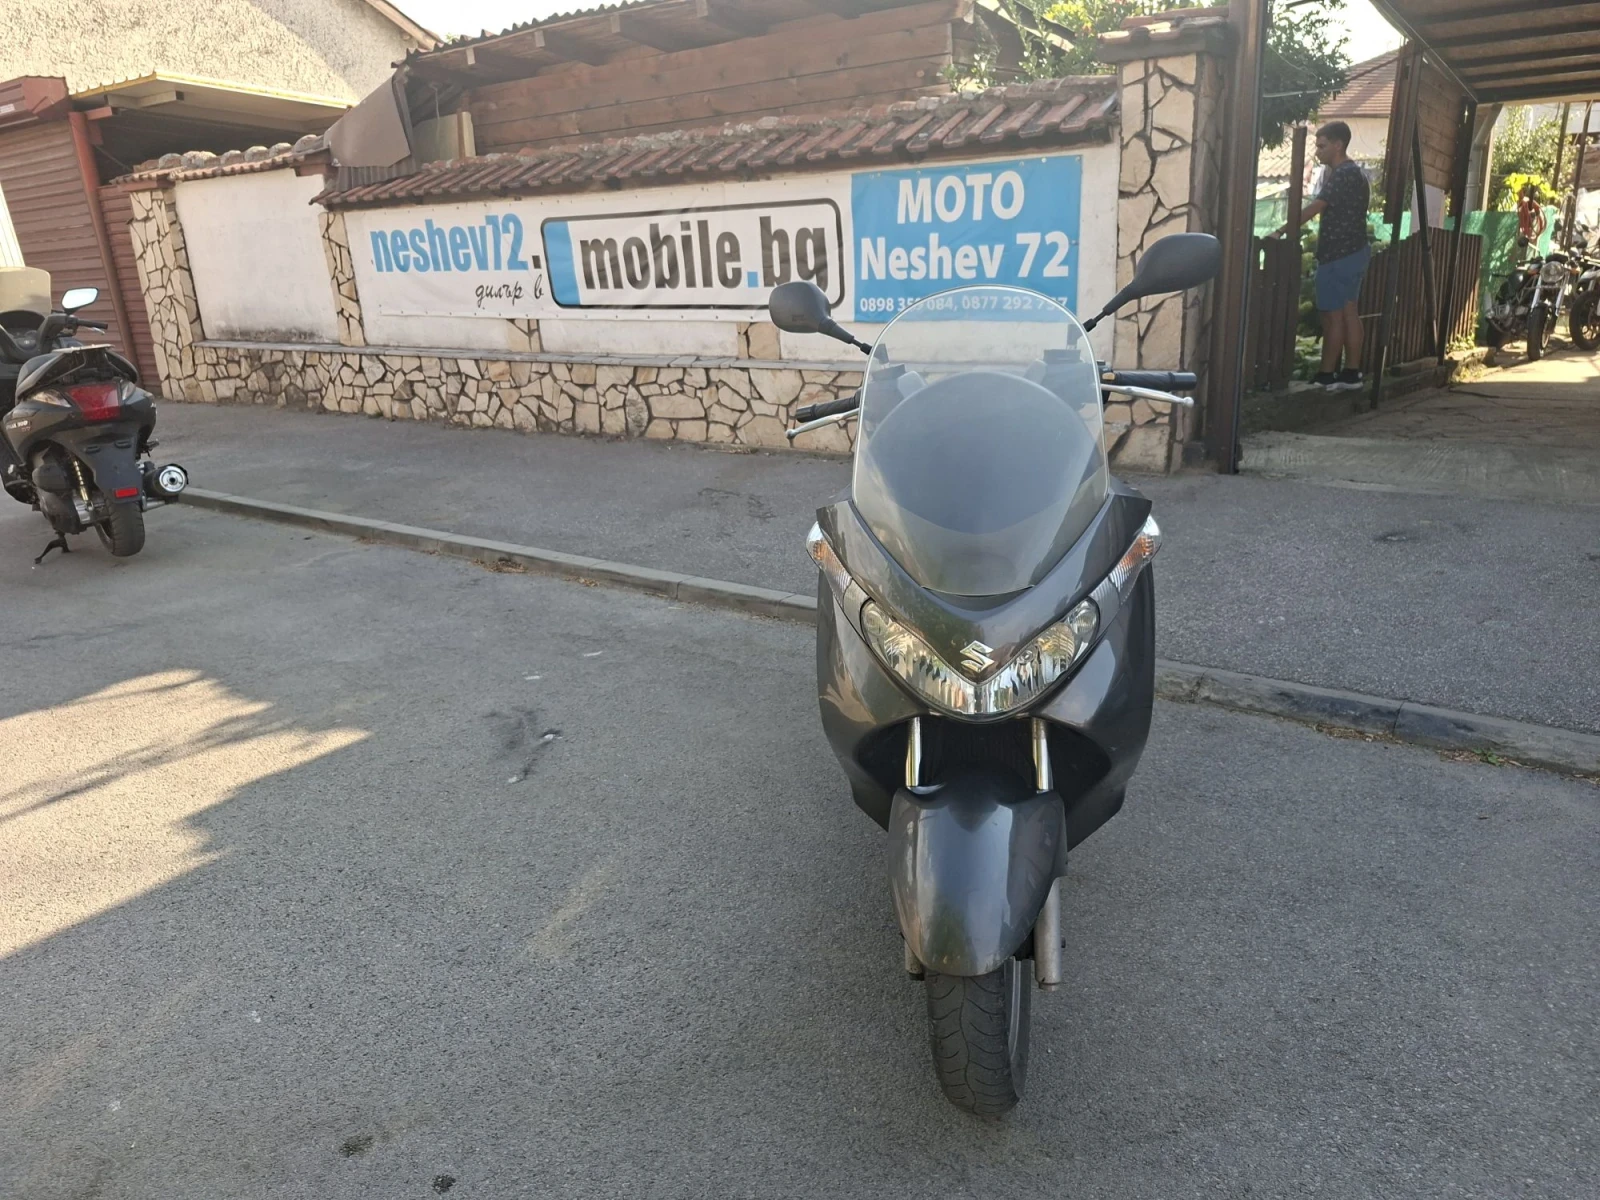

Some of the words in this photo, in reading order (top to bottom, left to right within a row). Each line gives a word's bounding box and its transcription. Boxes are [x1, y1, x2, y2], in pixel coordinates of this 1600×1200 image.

[897, 171, 1025, 224] MOTO
[861, 233, 1005, 280] Neshev
[1016, 231, 1069, 278] 72
[860, 297, 895, 312] 0898
[961, 294, 998, 309] 0877
[1002, 295, 1033, 310] 292
